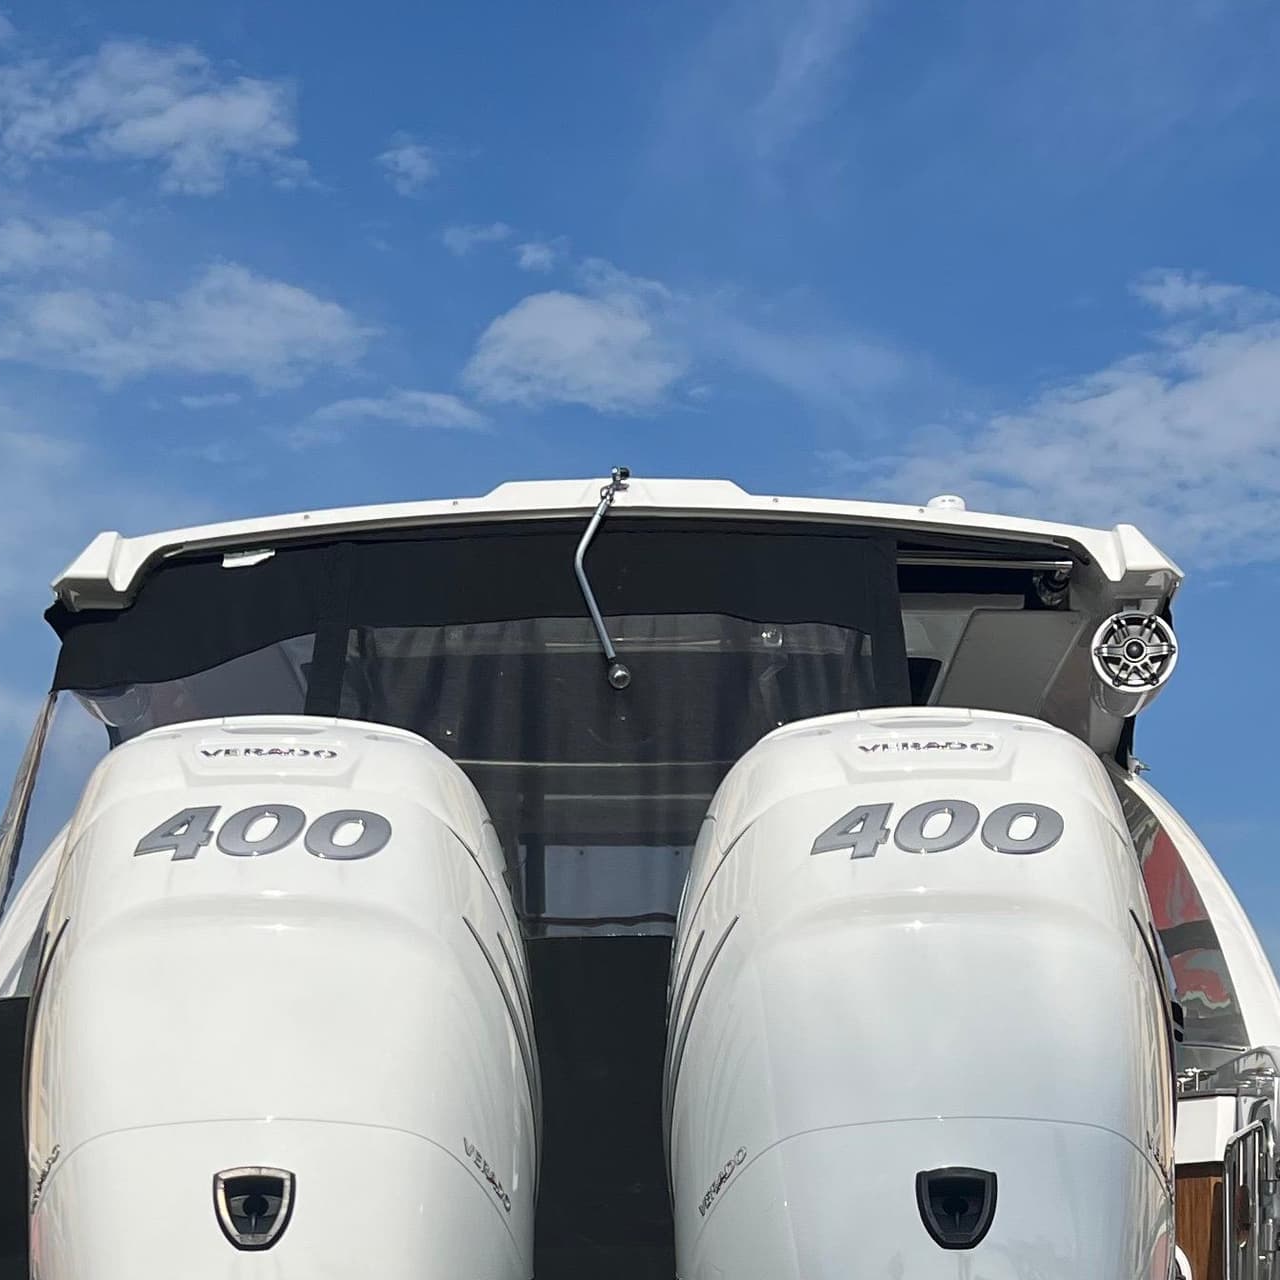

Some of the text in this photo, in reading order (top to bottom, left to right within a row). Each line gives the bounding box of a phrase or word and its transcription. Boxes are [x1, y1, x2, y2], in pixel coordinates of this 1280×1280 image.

[200, 748, 338, 758] VERADO
[133, 803, 393, 861] 400
[810, 799, 1065, 860] 400
[463, 1136, 512, 1212] VERADO
